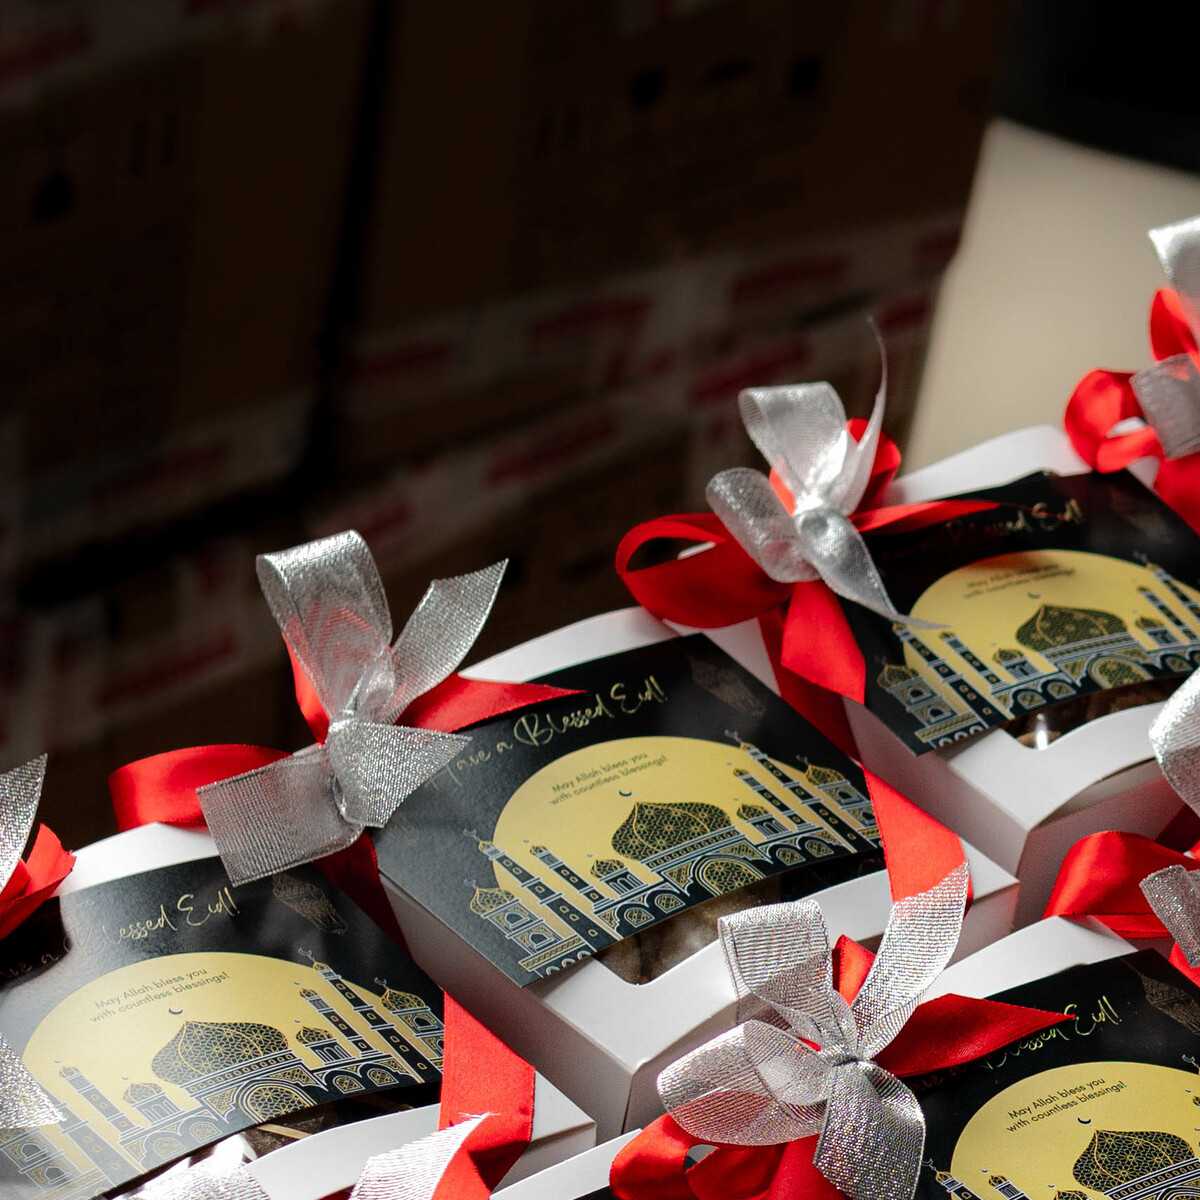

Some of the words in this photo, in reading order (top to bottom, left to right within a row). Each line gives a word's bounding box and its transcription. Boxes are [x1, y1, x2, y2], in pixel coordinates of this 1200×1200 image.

[513, 693, 615, 746] Blessed
[176, 887, 240, 926] Eid!
[1007, 1118, 1031, 1133] with
[1031, 1100, 1078, 1122] countless
[1076, 1080, 1127, 1104] blessings!
[1008, 1105, 1032, 1120] May
[1032, 1094, 1060, 1110] Allah
[1057, 1084, 1087, 1098] bless
[1086, 1078, 1106, 1090] you
